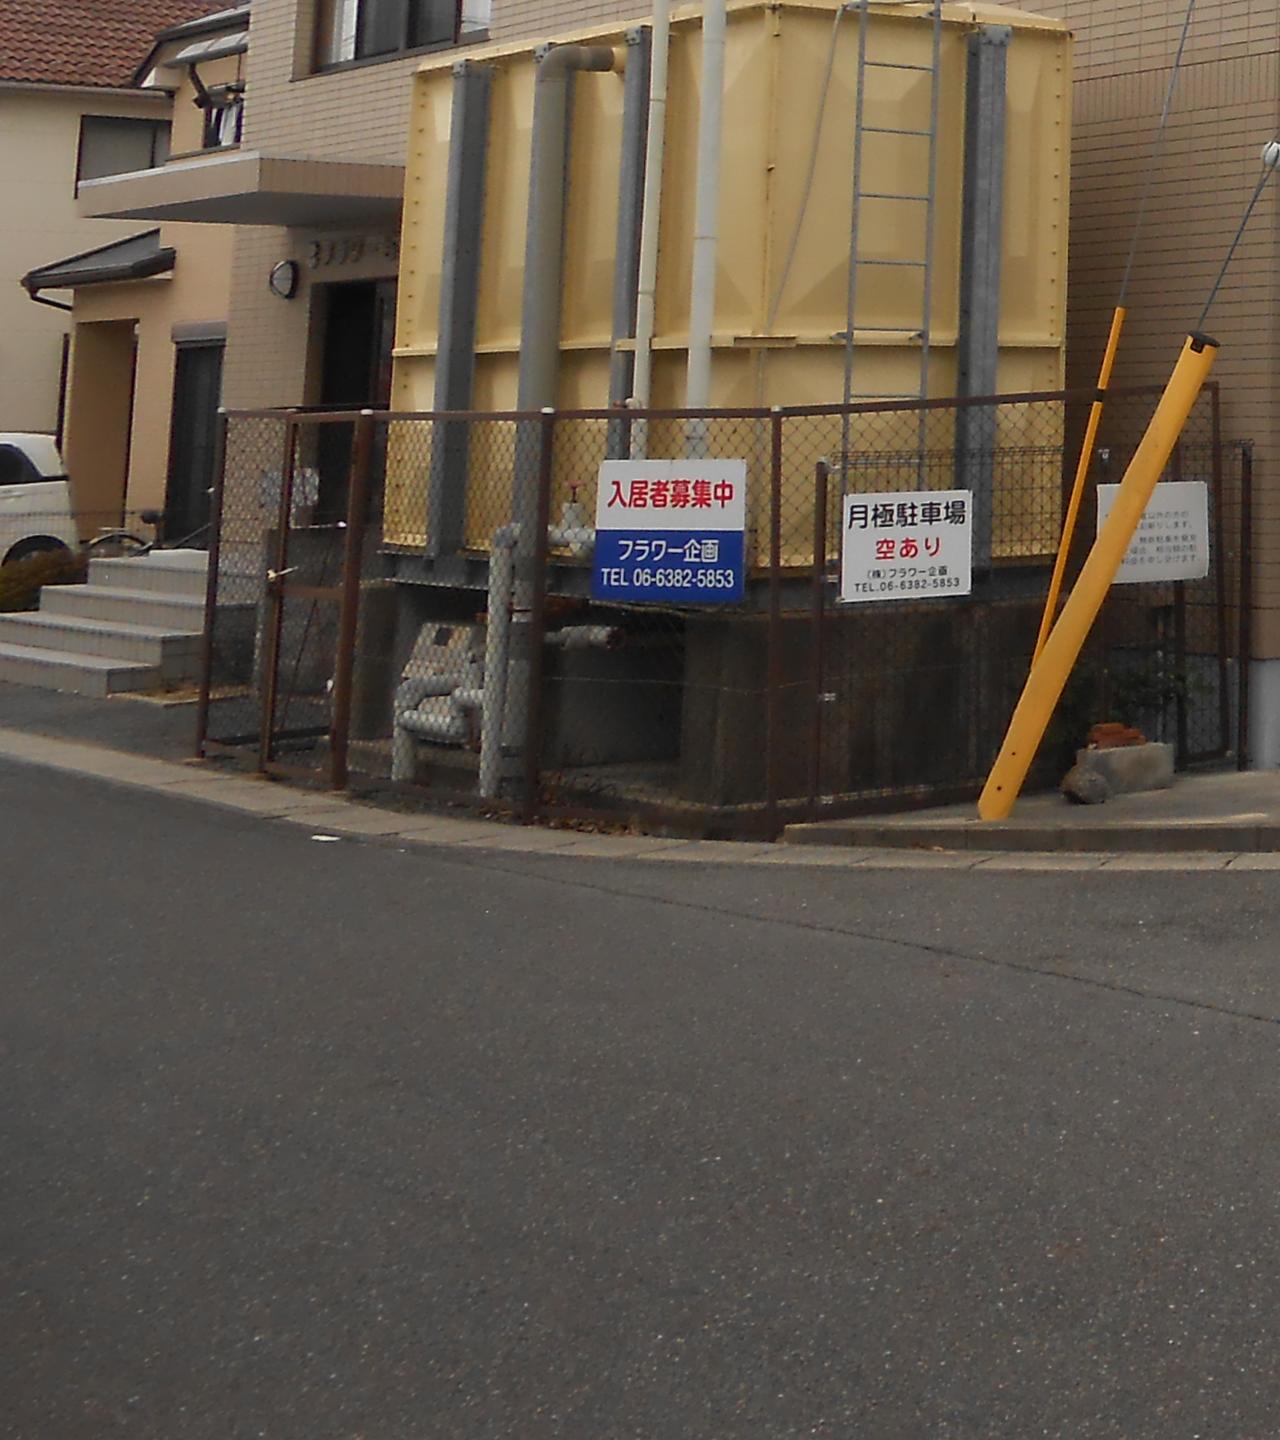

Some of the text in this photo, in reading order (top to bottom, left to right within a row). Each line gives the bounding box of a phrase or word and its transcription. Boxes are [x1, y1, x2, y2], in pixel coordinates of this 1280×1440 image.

[607, 479, 734, 509] 入居者募集中
[848, 500, 966, 529] 月極駐車場
[618, 539, 719, 563] フラワー企画
[875, 537, 940, 560] 空あり
[601, 568, 735, 588] TEL 06-6382-5853
